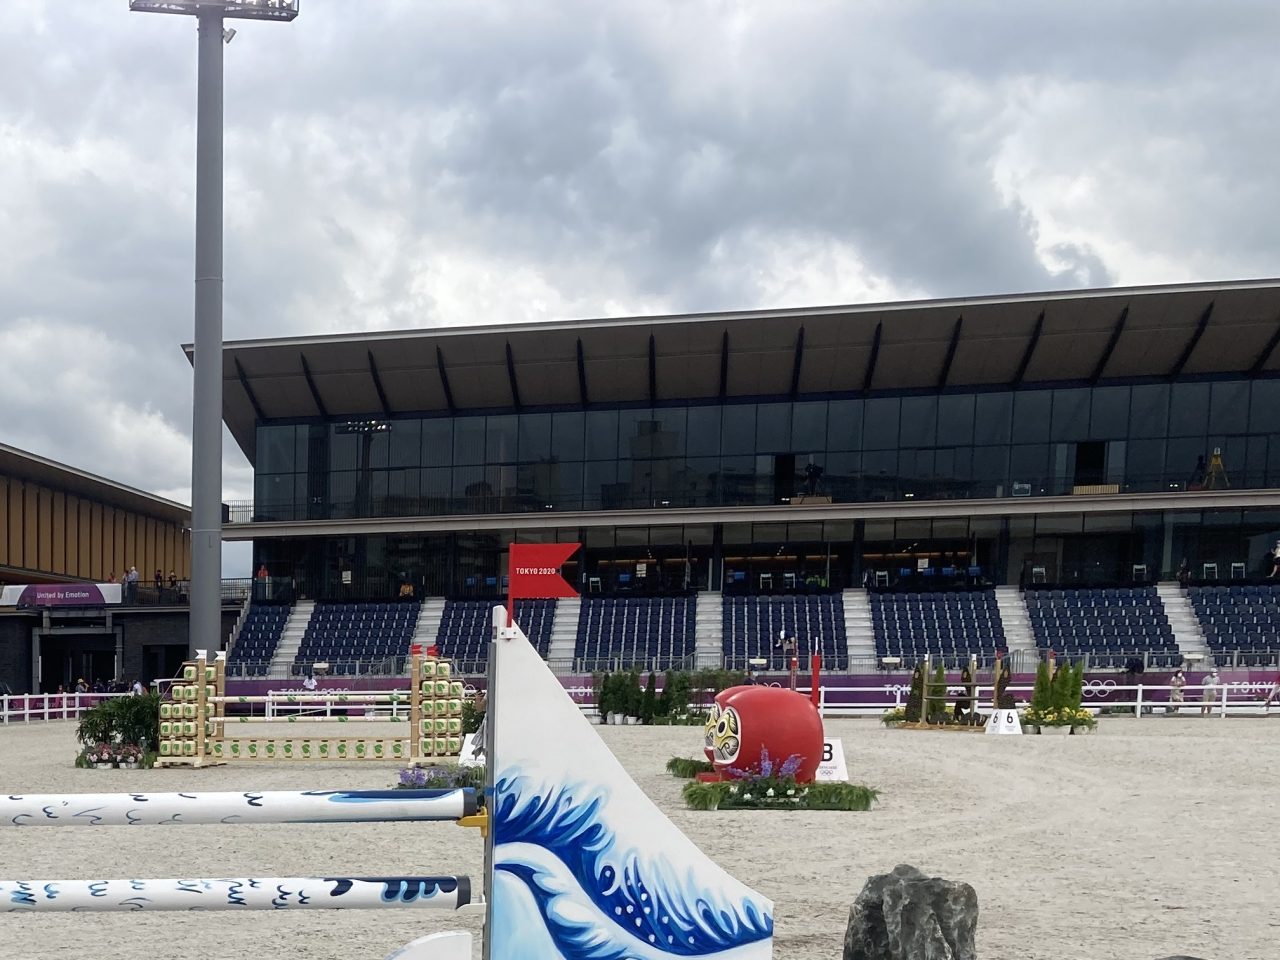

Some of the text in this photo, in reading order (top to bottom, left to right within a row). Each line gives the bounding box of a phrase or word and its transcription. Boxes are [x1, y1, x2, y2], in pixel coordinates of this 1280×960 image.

[515, 567, 556, 575] TOKYO 2020
[57, 592, 64, 600] by
[65, 591, 89, 599] Emotion
[993, 712, 998, 723] 6
[1006, 711, 1013, 723] 6
